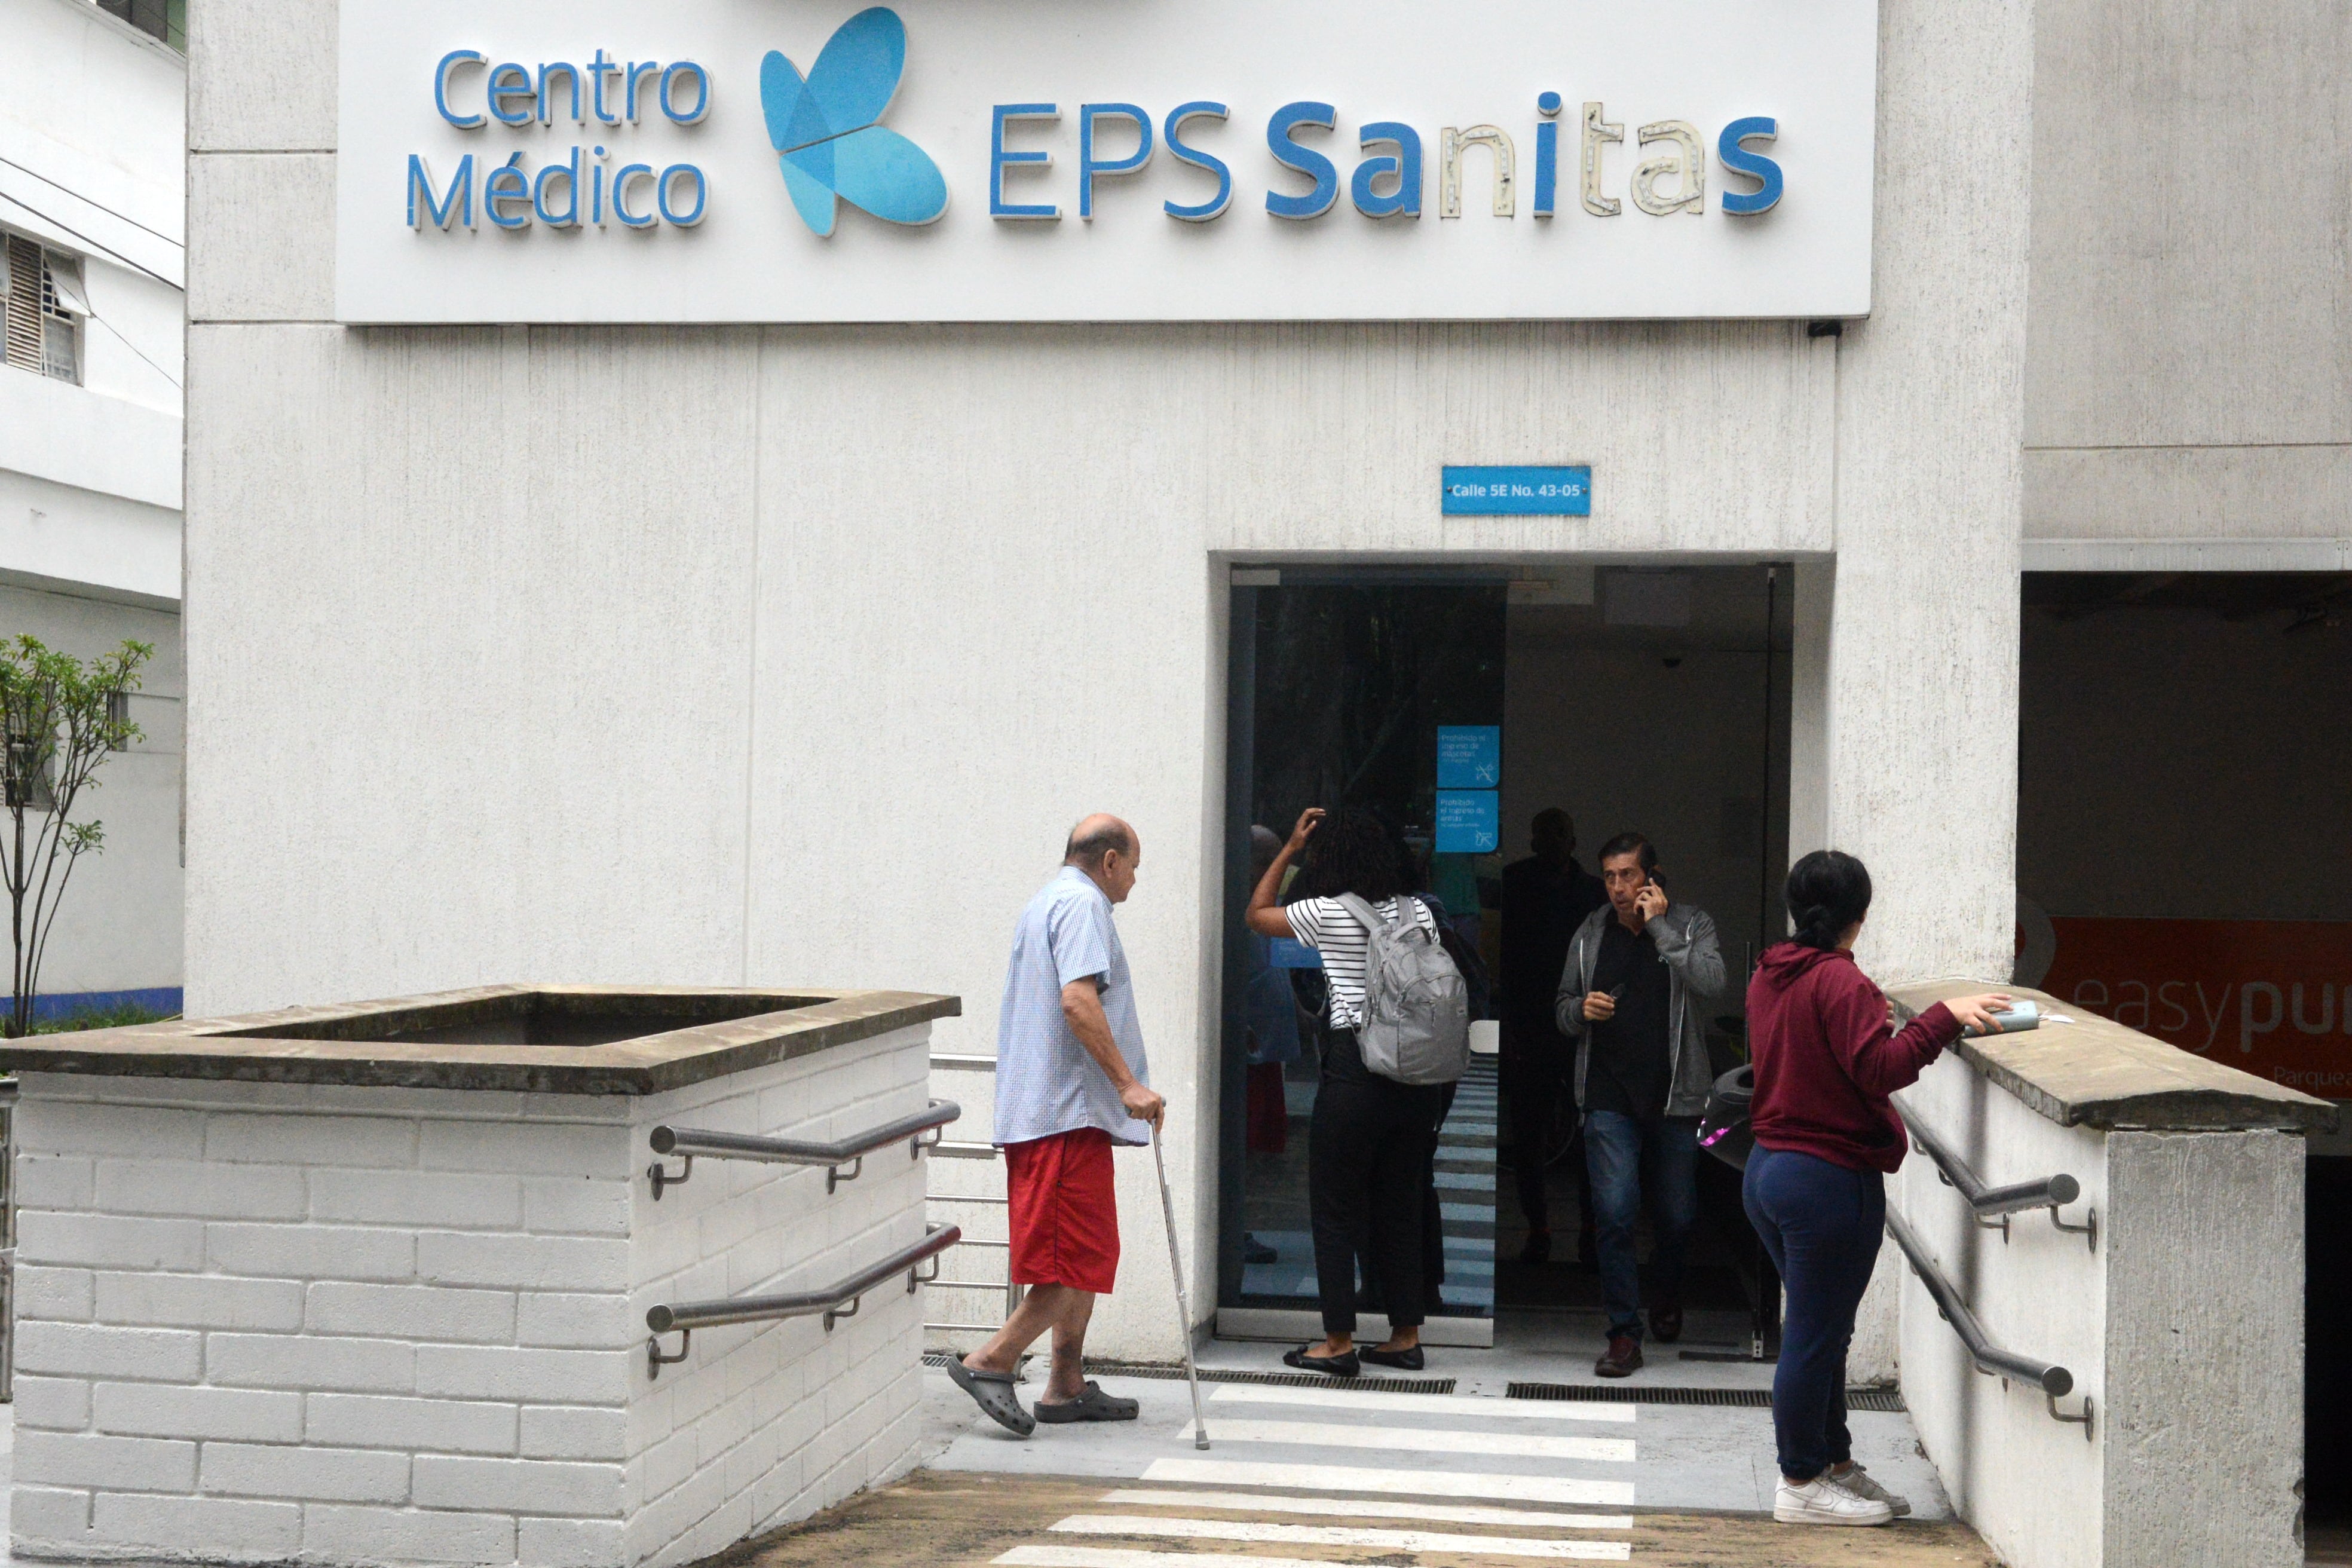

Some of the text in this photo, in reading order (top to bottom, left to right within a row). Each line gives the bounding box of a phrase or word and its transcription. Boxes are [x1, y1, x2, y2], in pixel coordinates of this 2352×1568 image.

[434, 48, 712, 128] Centro
[407, 145, 710, 230] Médico
[1453, 484, 1580, 497] Calle 5E No. 43-05
